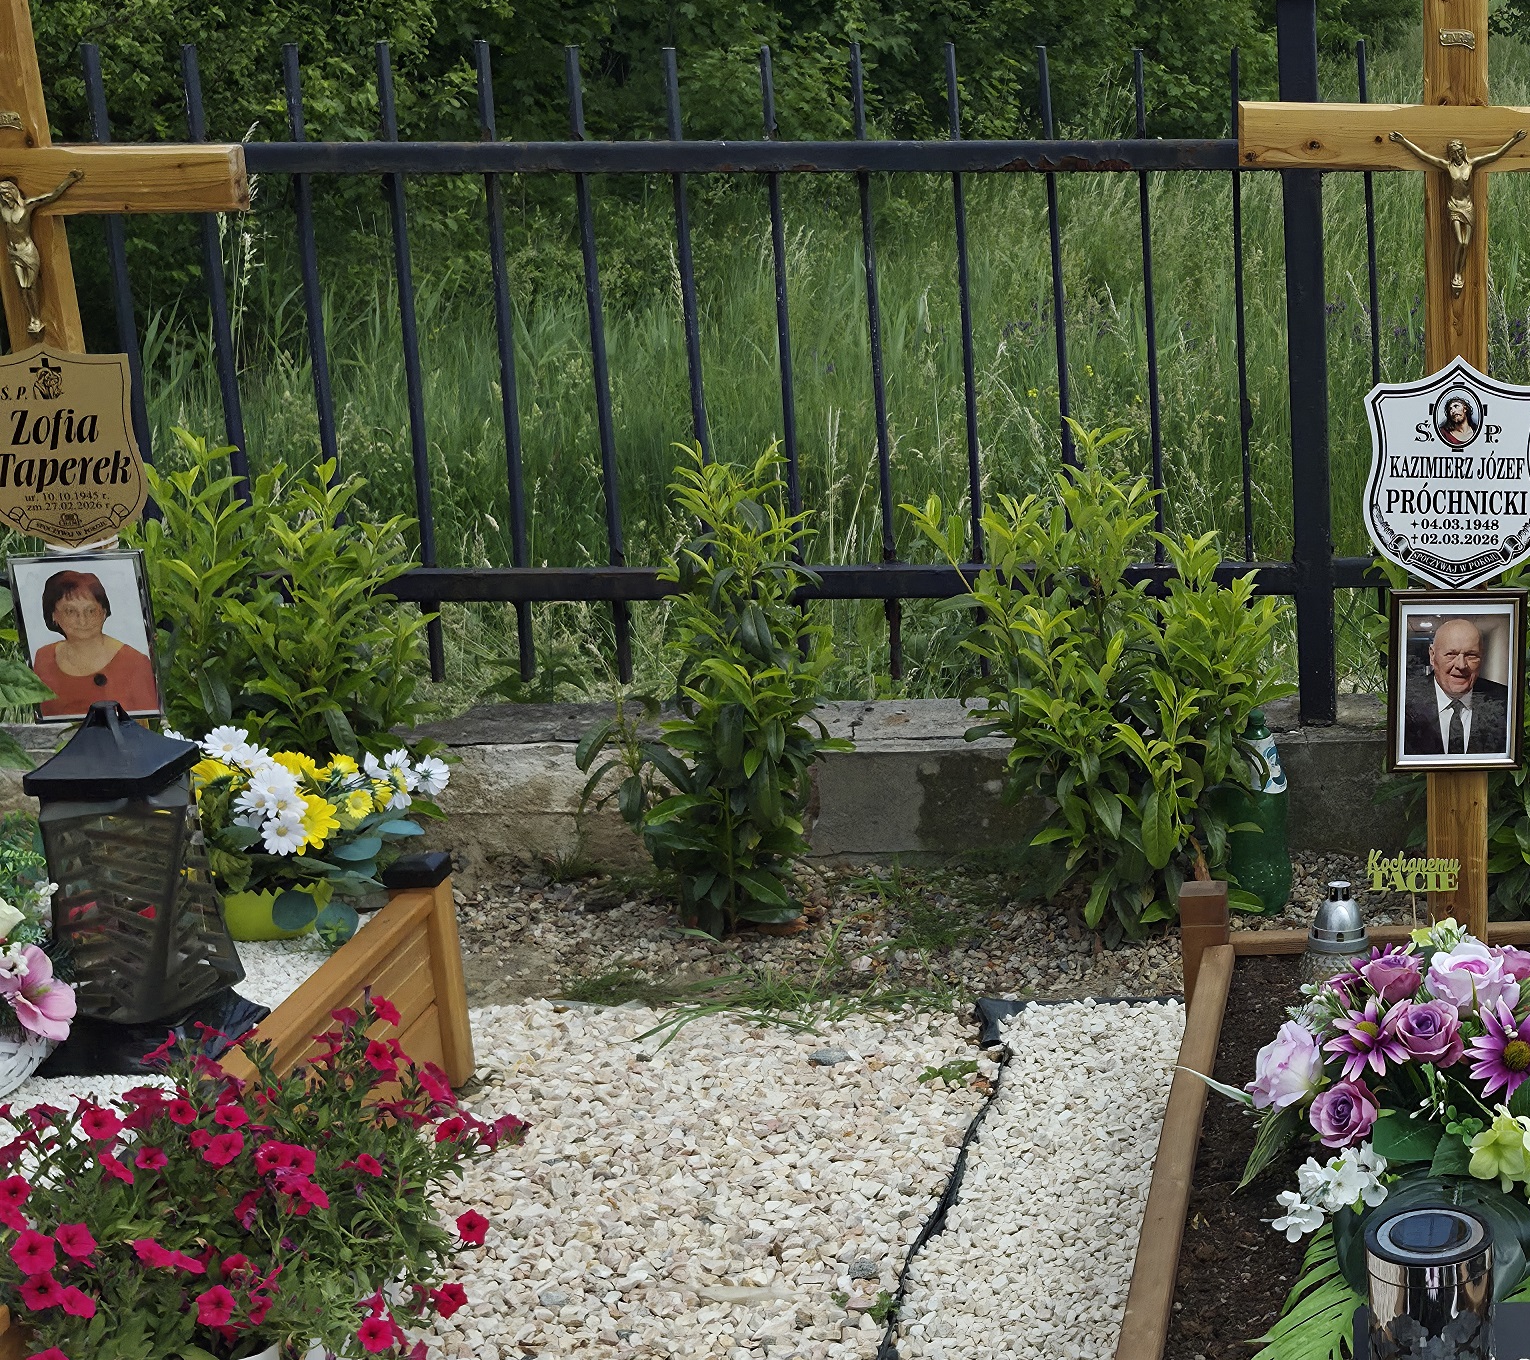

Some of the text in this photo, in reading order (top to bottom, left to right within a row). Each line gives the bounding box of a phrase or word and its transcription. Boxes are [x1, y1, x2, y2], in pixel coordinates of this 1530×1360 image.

[11, 408, 99, 450] Zofia
[1414, 420, 1503, 444] Ś. P.
[0, 450, 132, 493] Taperek
[1389, 451, 1526, 480] KAZIMIERZ JÓZEF
[1385, 482, 1529, 516] PRÓCHNICKI
[1411, 552, 1499, 574] SPOCZYWAJ W POKOJU
[1367, 848, 1462, 874] Kochanemu
[1367, 871, 1459, 893] TACIE
